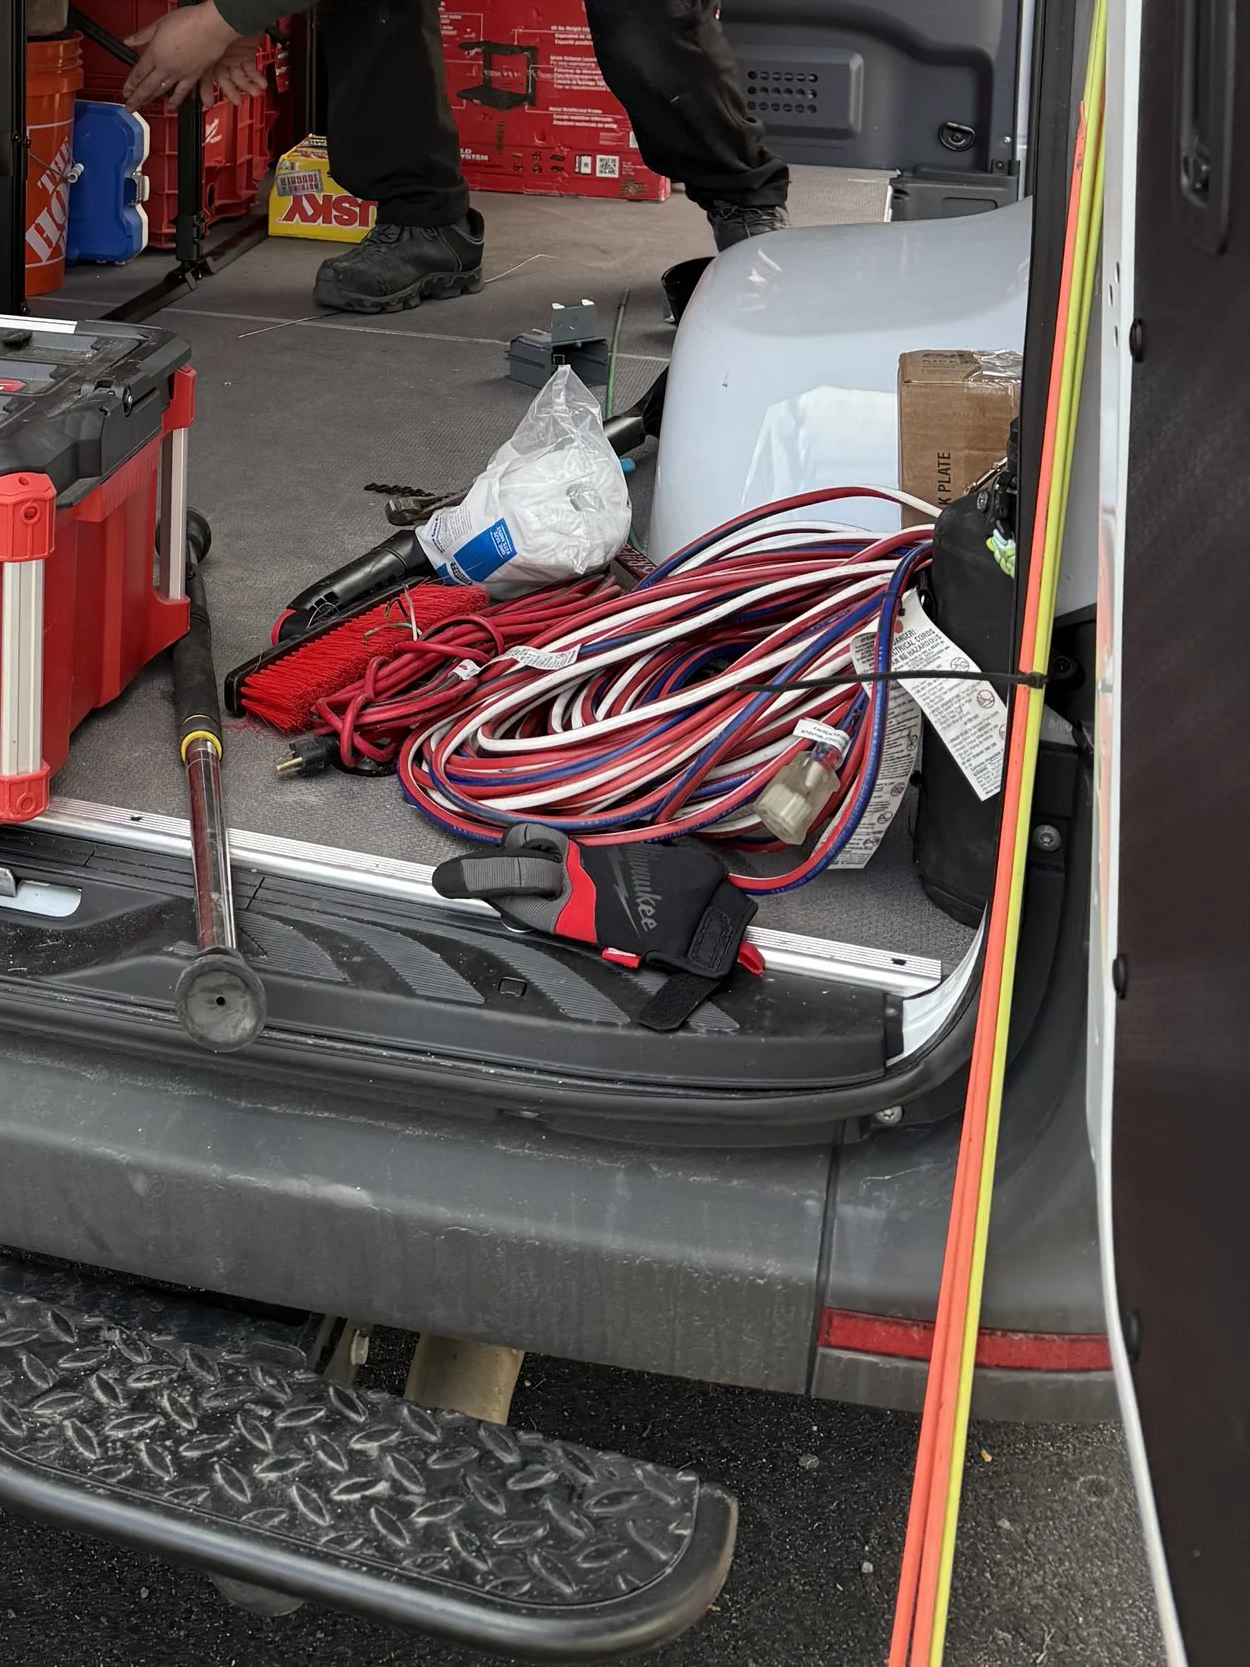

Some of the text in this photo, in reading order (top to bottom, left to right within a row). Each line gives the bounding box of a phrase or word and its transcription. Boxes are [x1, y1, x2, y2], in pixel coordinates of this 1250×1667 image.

[25, 183, 70, 262] HO
[283, 193, 378, 228] USKY
[937, 451, 951, 494] PLATE
[892, 639, 917, 656] CTRICAL
[914, 628, 936, 643] CORDS
[900, 653, 908, 662] BE
[907, 633, 942, 657] HAZARDOUS
